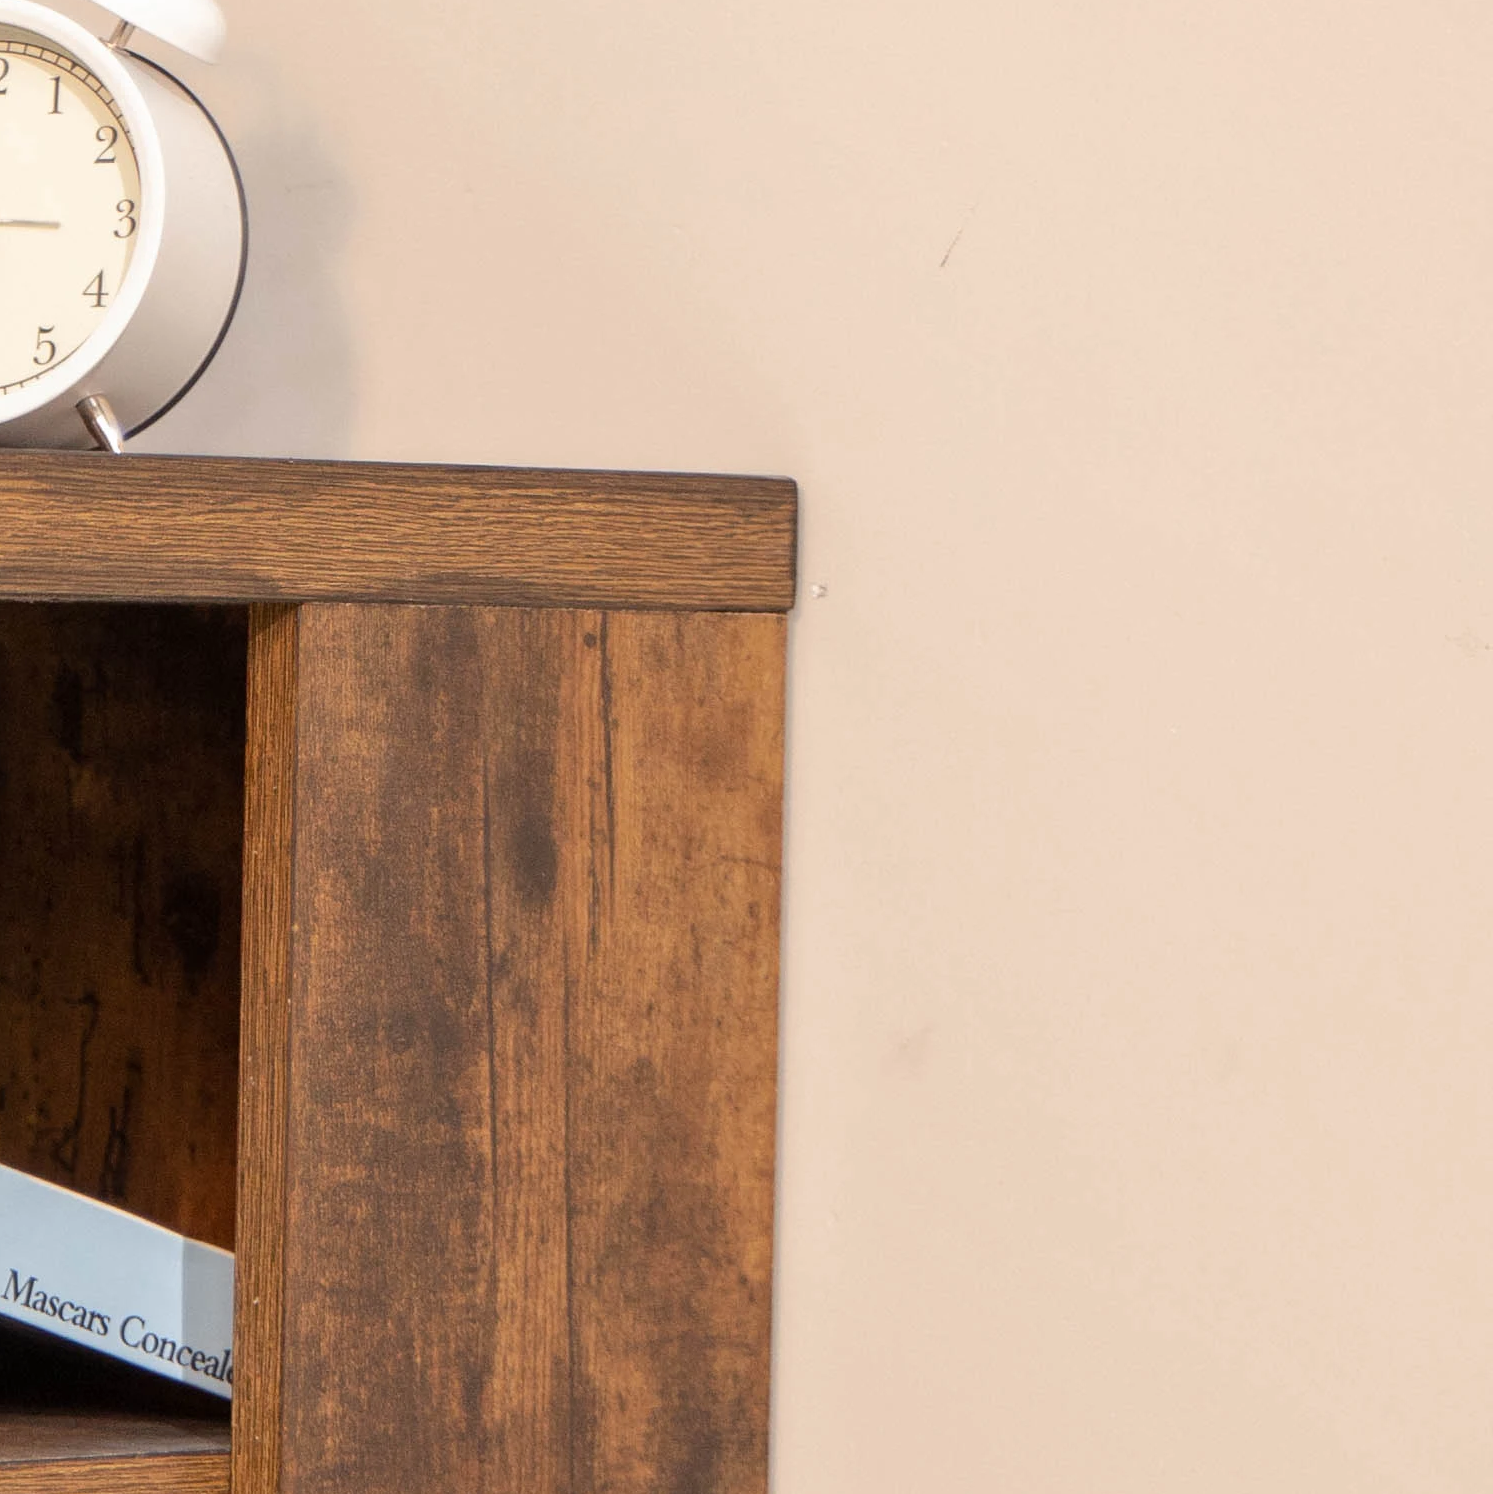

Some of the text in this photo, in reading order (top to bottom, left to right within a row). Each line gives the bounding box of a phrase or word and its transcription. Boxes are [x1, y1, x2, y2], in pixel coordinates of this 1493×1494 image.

[47, 75, 64, 114] 1
[94, 125, 118, 164] 2
[113, 199, 137, 238] 3
[82, 269, 109, 308] 4
[33, 325, 57, 366] 5
[0, 1267, 112, 1337] Mascars
